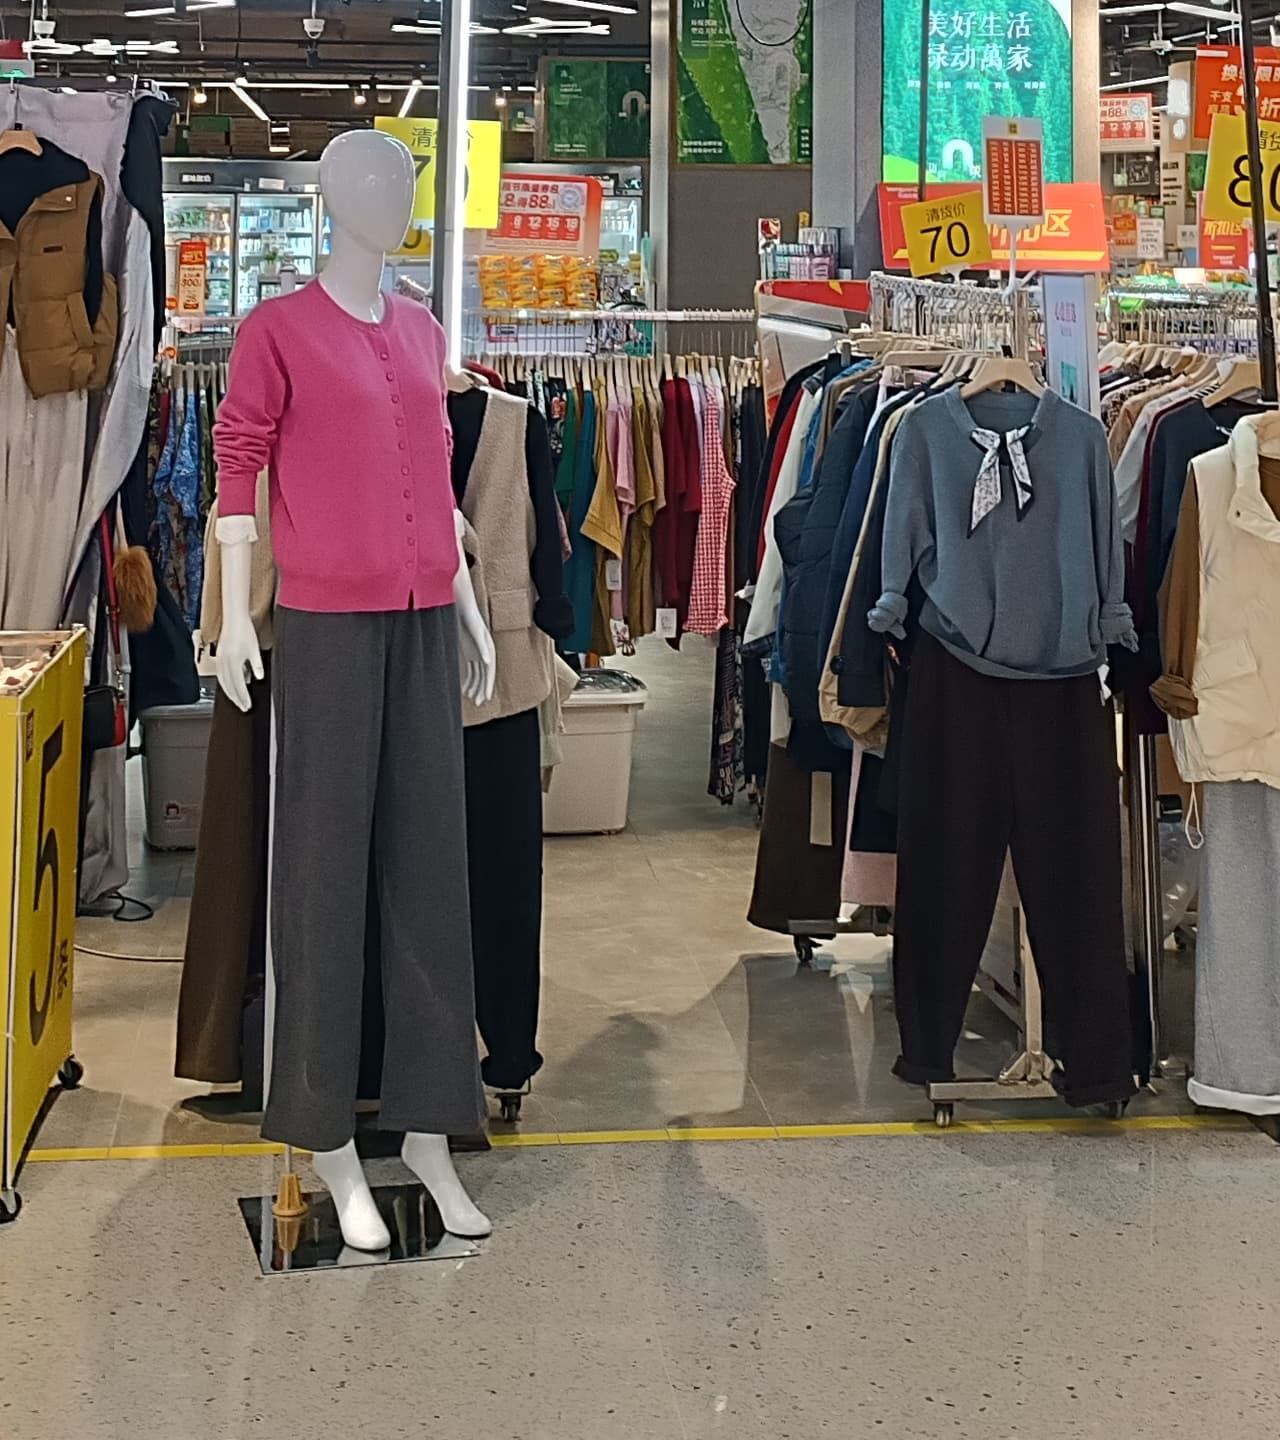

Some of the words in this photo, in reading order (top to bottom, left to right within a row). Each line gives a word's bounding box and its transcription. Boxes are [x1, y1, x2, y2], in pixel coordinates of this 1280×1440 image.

[928, 10, 1033, 40] 美好生活
[925, 202, 966, 223] 清货价
[920, 221, 971, 263] 70
